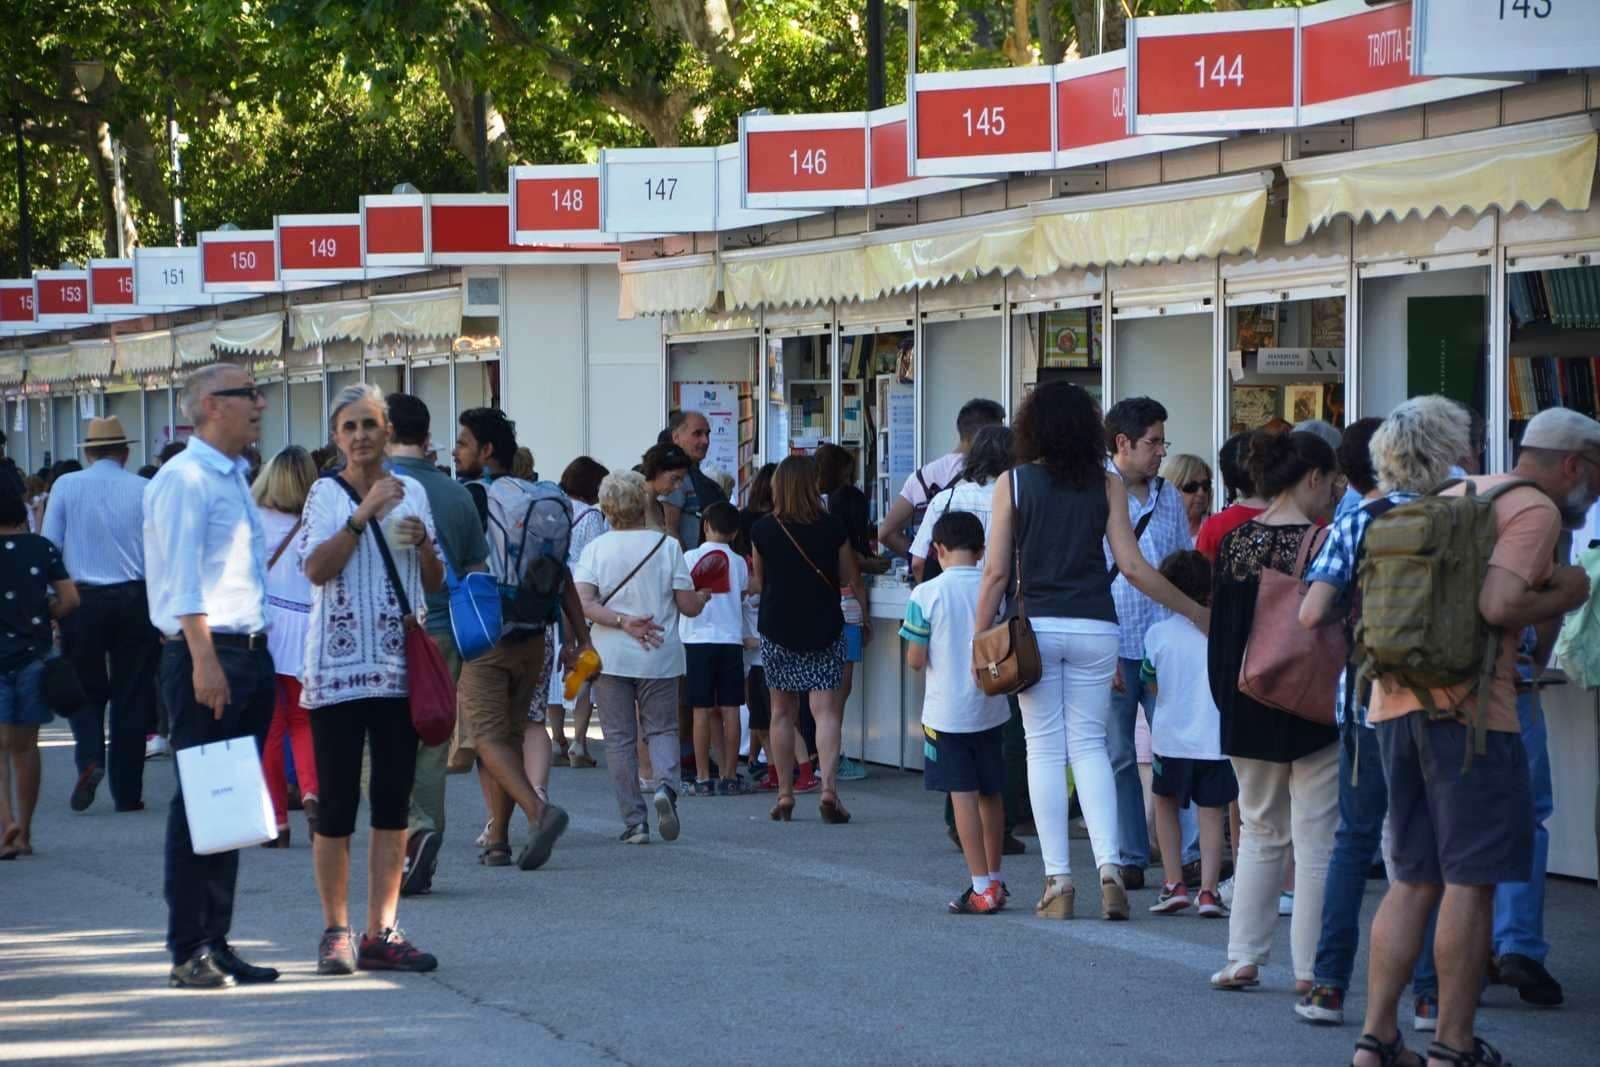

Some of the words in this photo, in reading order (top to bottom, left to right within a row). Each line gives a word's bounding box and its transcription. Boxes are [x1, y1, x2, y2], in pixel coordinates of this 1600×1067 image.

[1367, 29, 1402, 67] TROTTA
[1194, 54, 1245, 88] 144
[962, 106, 1006, 137] 145
[788, 148, 827, 176] 146
[644, 178, 678, 200] 147
[551, 190, 583, 211] 148
[309, 239, 336, 257] 149
[231, 252, 256, 270] 150
[162, 269, 185, 285] 151
[60, 286, 81, 302] 153
